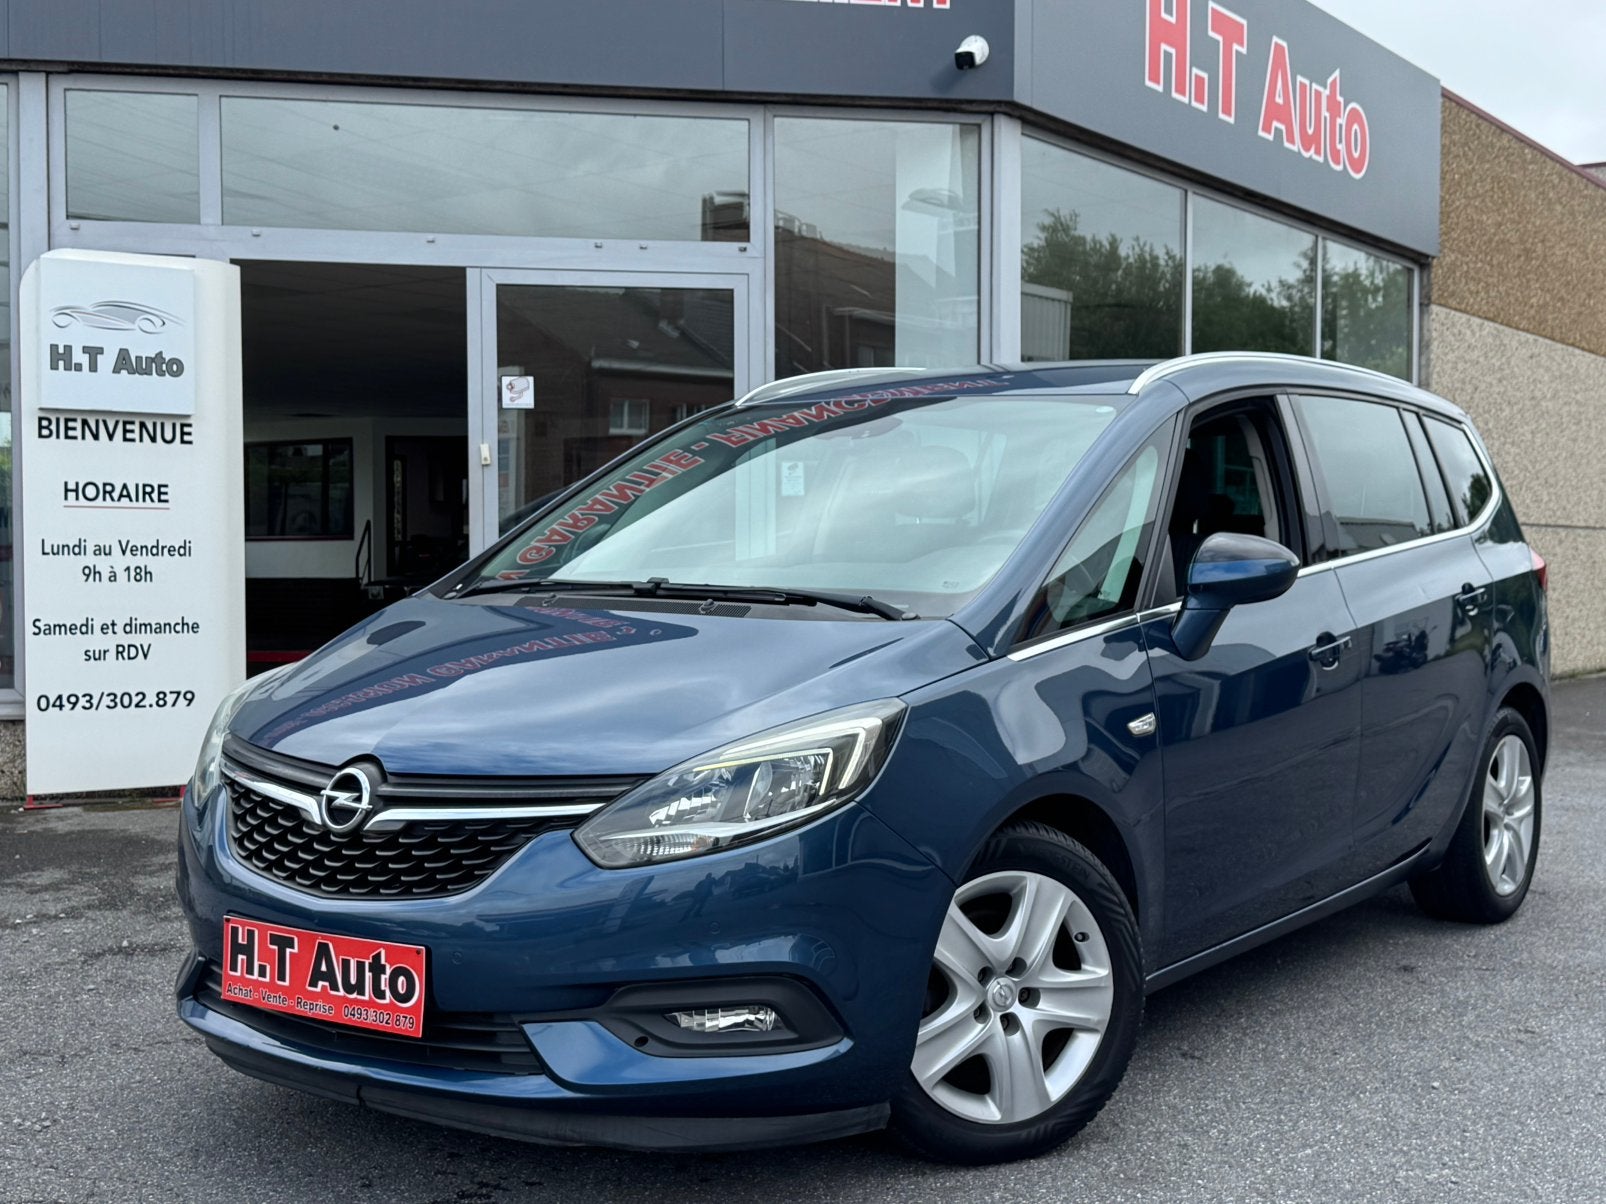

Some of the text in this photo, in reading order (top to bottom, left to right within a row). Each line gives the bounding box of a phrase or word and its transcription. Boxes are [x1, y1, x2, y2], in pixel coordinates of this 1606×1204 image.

[1145, 0, 1370, 180] H.T Auto
[49, 344, 185, 378] H.T Auto
[37, 416, 194, 445] BIENVENUE
[64, 481, 170, 503] HORAIRE
[41, 538, 192, 557] Lundi au Vendredi
[82, 565, 153, 582] 9h à 18h
[32, 616, 200, 636] Samedi et dimanche
[84, 644, 152, 662] sur RDV
[36, 690, 196, 712] 0493/302.879
[228, 923, 420, 1008] H.T Auto
[226, 982, 253, 999] Achat
[260, 989, 288, 1006] Vente
[296, 996, 334, 1016] Reprise
[394, 1013, 415, 1030] 879
